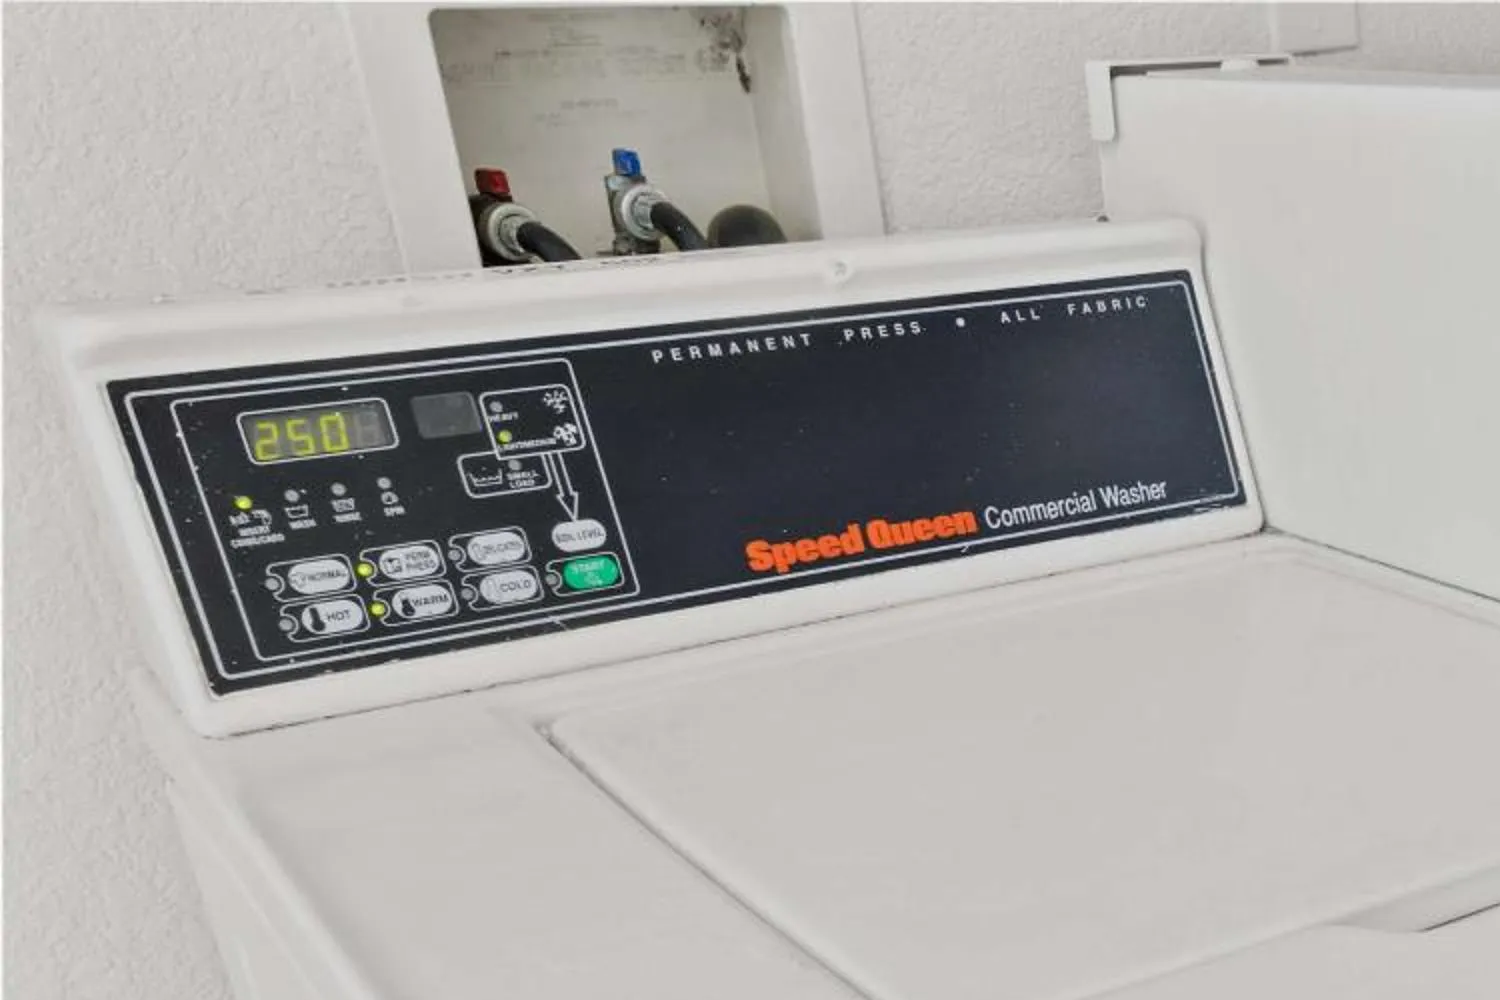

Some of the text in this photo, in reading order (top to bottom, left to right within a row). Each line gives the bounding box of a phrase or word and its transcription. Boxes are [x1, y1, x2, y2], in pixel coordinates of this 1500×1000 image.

[1000, 295, 1147, 324] ALL FABRIC
[651, 321, 922, 364] PERMANENT PRESS
[254, 411, 350, 461] 250
[744, 478, 1168, 575] Speed Queen Commercial Washer
[411, 593, 448, 608] WARM
[500, 578, 533, 594] COLD
[326, 608, 352, 623] HOT
